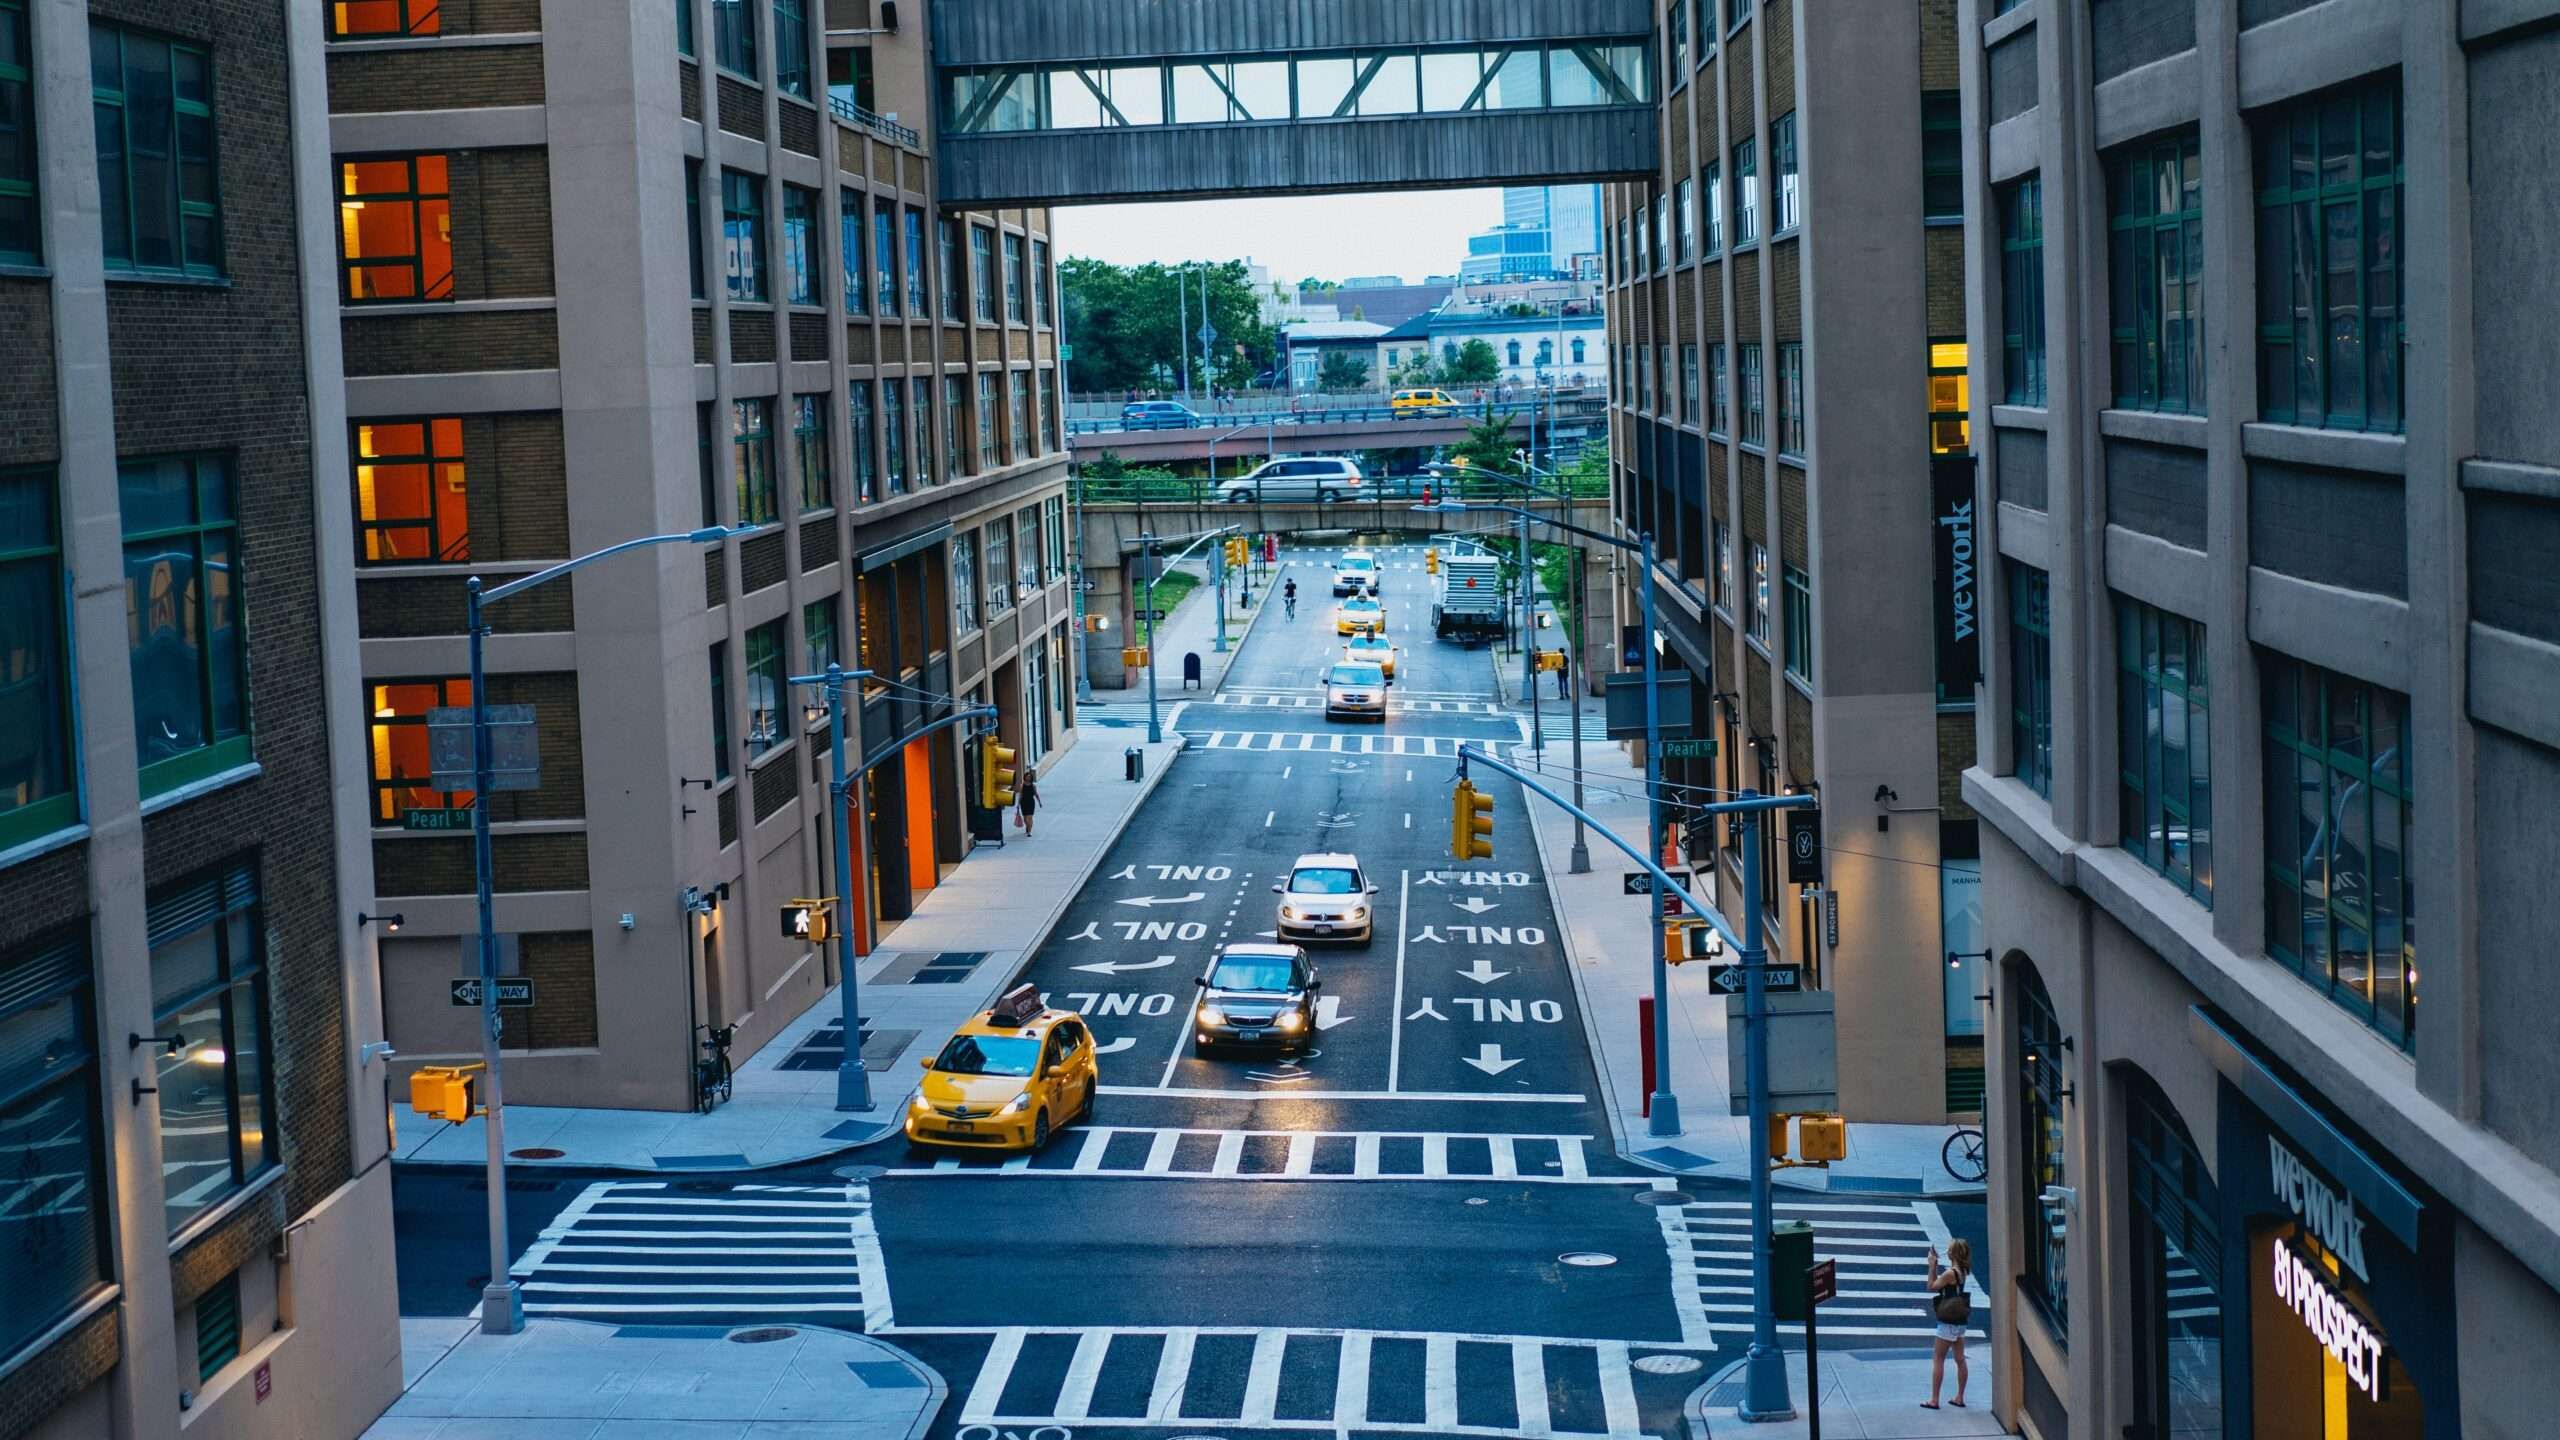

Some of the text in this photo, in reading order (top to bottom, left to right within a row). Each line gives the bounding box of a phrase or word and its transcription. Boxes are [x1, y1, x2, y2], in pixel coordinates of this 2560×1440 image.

[1939, 498, 1974, 642] wework
[1667, 742, 1699, 756] Pearl
[411, 811, 451, 828] Pearl
[1109, 865, 1232, 881] ONLY
[1415, 871, 1531, 887] ONLY
[1066, 922, 1207, 941] ONLY
[1409, 925, 1545, 945] ONLY
[1723, 973, 1747, 986] ONE
[501, 987, 524, 998] WAY
[1040, 992, 1175, 1016] ONL
[1405, 997, 1563, 1023] ONLY
[2268, 1133, 2370, 1285] wework
[2274, 1237, 2382, 1403] 81 PROSPECT
